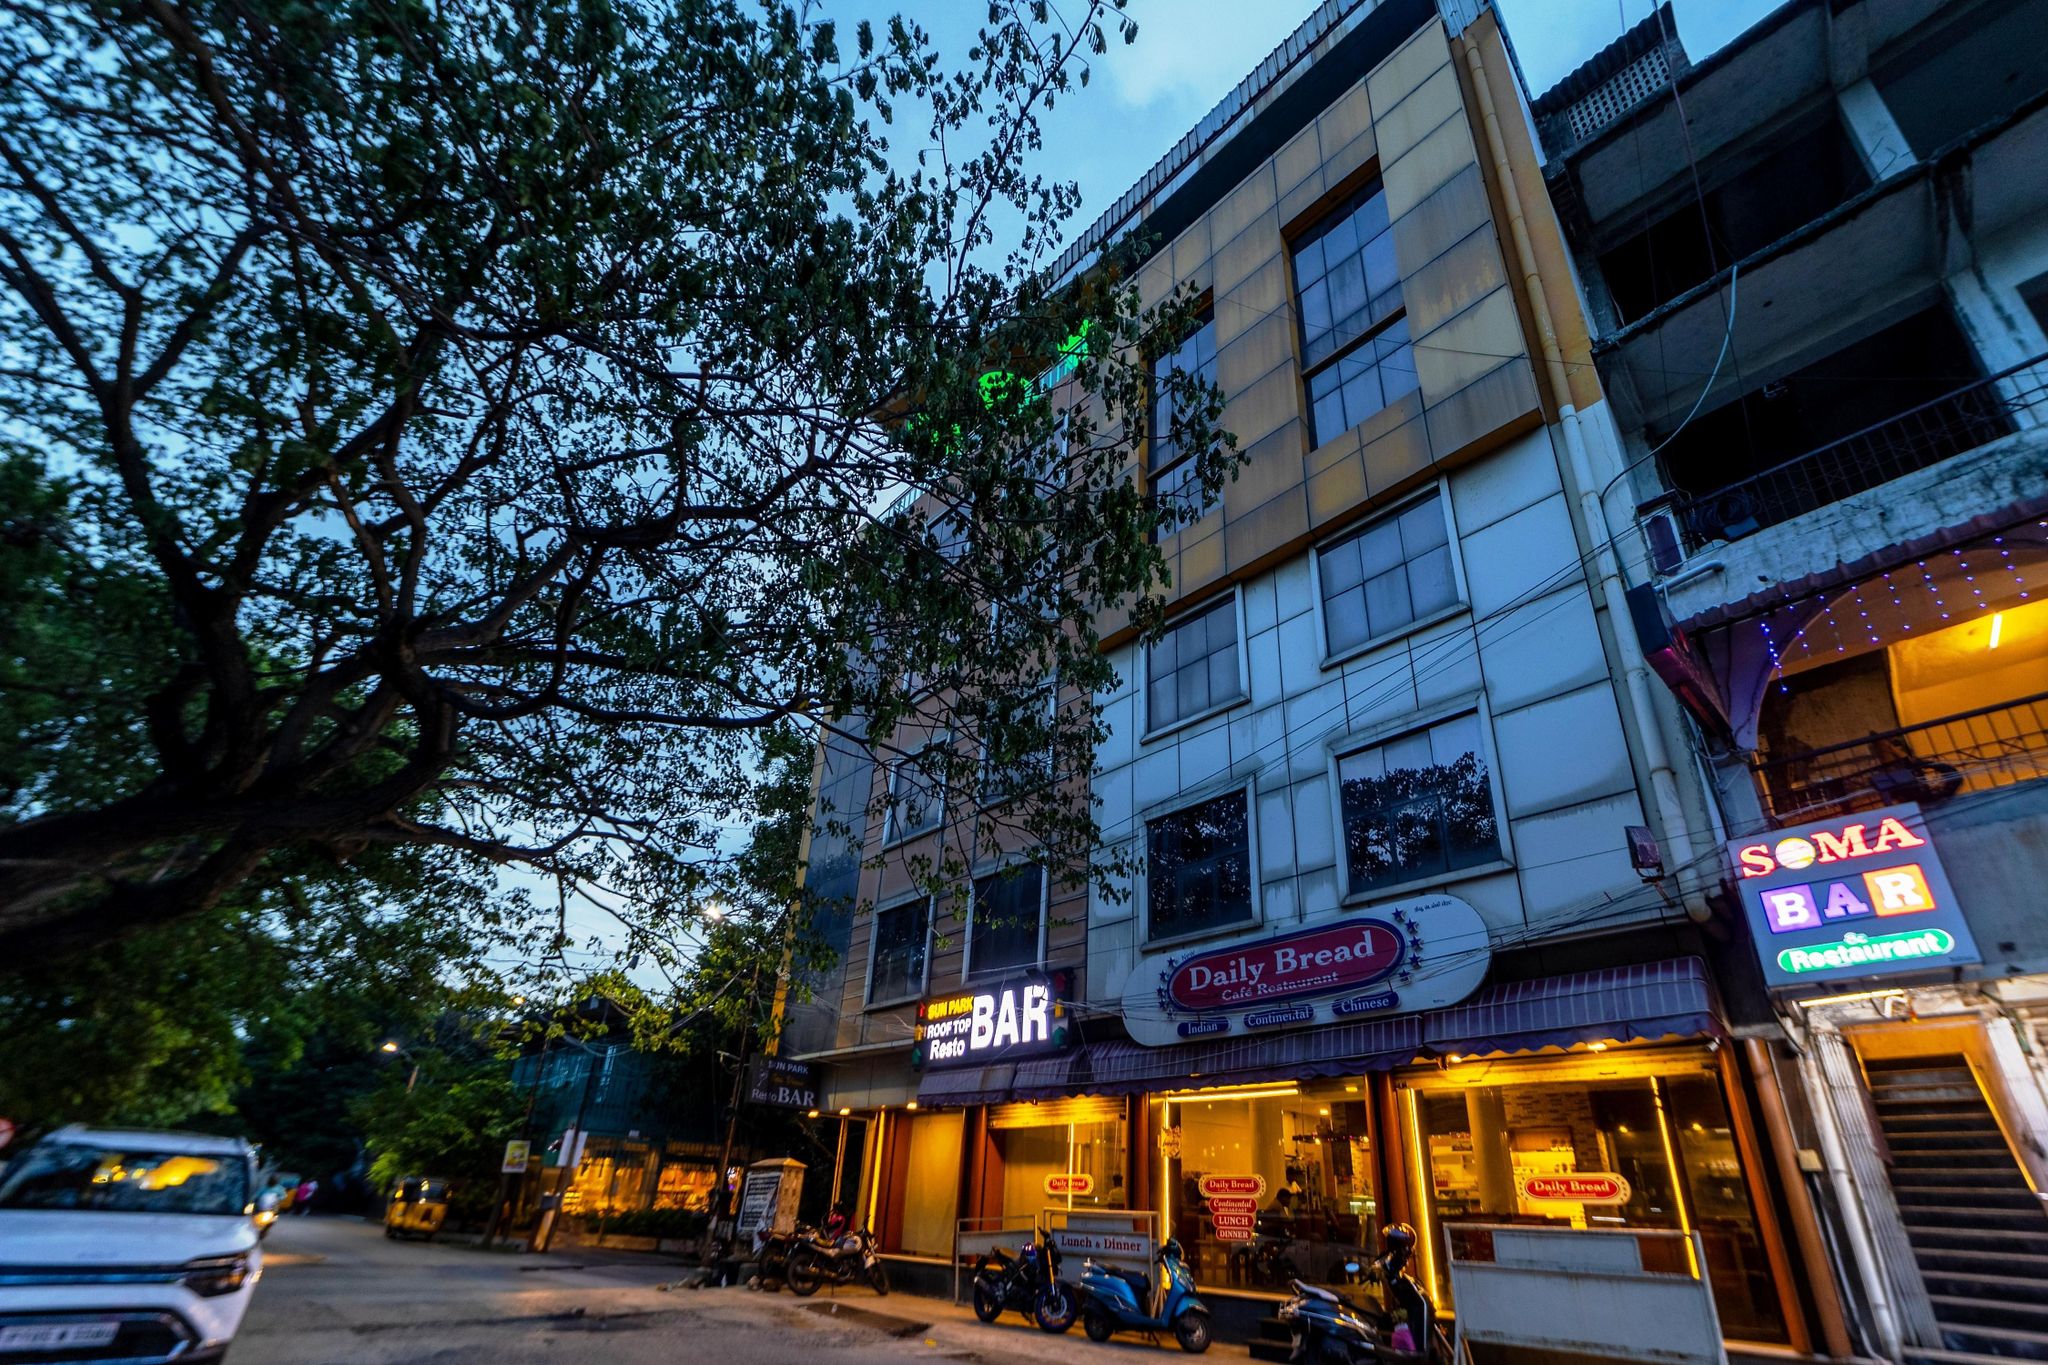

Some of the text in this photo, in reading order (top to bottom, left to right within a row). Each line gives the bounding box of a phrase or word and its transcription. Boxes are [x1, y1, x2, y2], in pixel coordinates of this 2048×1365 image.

[1738, 817, 1927, 878] SOMA
[1770, 871, 1925, 926] BAR
[1843, 931, 1868, 945] &
[1188, 929, 1376, 991] Daily Bread
[1789, 933, 1940, 971] Restaurant
[1221, 971, 1339, 1001] Café Restaurant
[927, 995, 974, 1020] SUN PARK
[1341, 997, 1390, 1013] Chinese
[970, 984, 1049, 1050] BAR
[1247, 1006, 1311, 1027] Continental
[927, 1017, 971, 1040] ROOF TOP
[1188, 1021, 1218, 1035] Indian
[929, 1037, 965, 1060] Resto
[787, 1063, 808, 1074] PARK
[778, 1086, 815, 1107] BAR
[1052, 1179, 1067, 1188] Daily
[1209, 1179, 1255, 1190] Daily Bread
[1534, 1180, 1610, 1192] Daily Bread
[1213, 1198, 1253, 1208] Continental
[1218, 1216, 1248, 1226] LUNCH
[1061, 1235, 1092, 1248] Lunch
[1104, 1237, 1142, 1252] Dinner
[1219, 1229, 1249, 1239] DINNER
